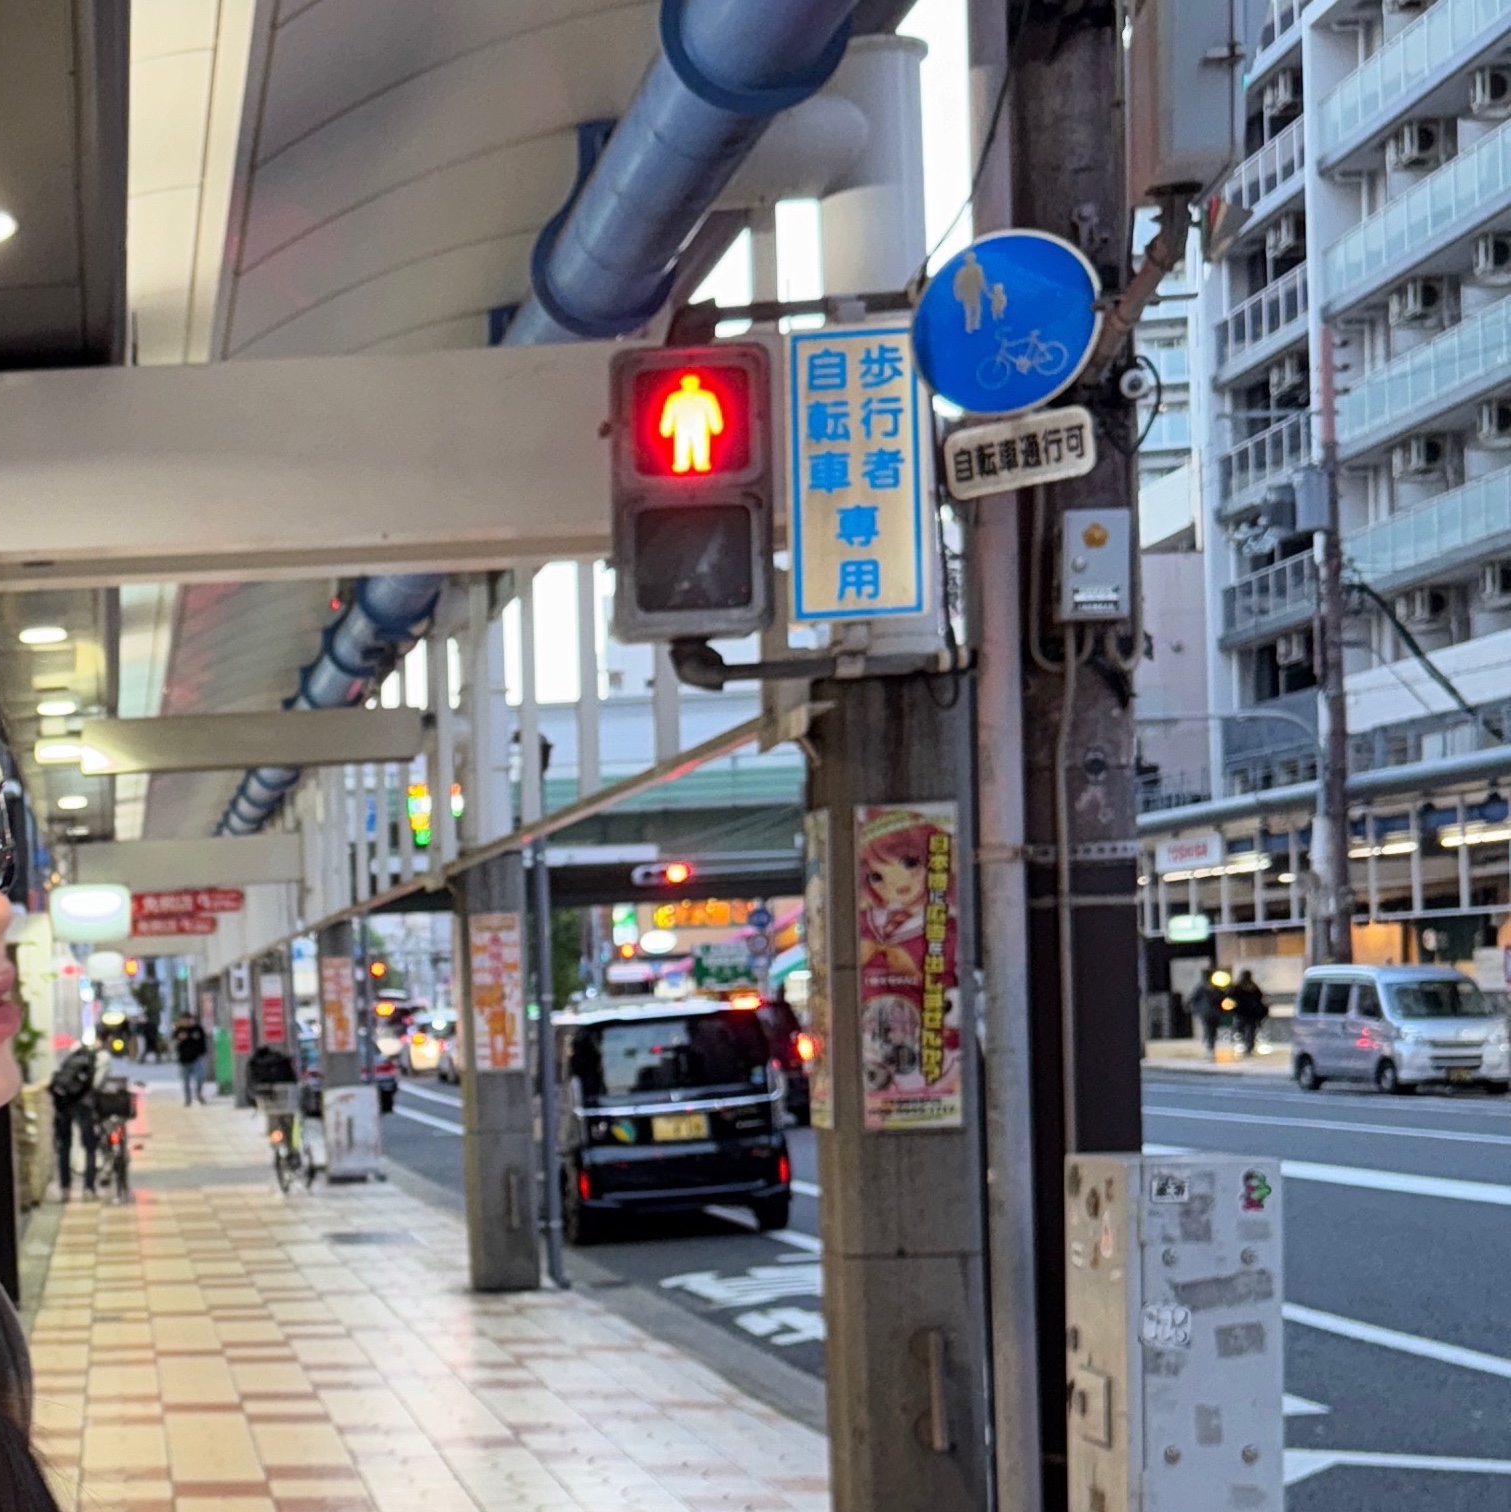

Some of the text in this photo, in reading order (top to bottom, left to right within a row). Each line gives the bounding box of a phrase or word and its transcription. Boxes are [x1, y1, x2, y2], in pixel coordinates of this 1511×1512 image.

[806, 348, 851, 493] 自転車
[859, 344, 904, 490] 歩行者
[953, 423, 1085, 483] 自転車通行可
[836, 504, 879, 601] 専用
